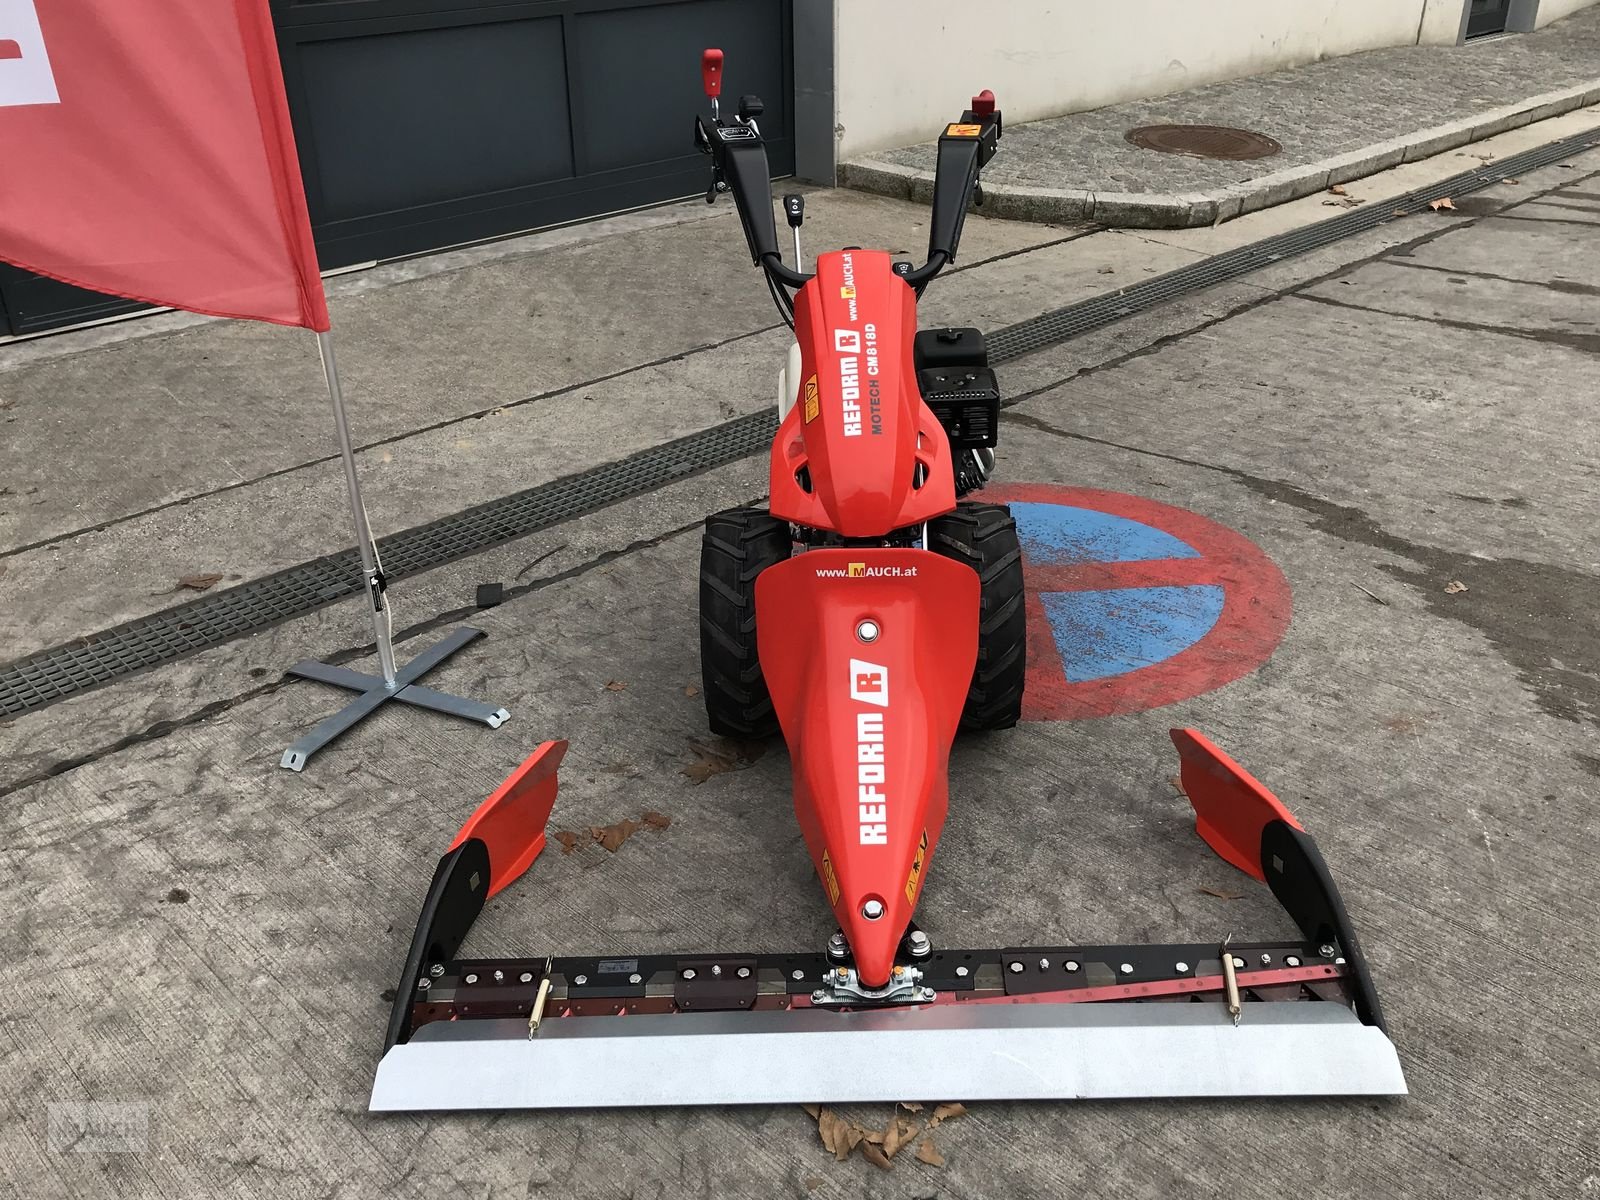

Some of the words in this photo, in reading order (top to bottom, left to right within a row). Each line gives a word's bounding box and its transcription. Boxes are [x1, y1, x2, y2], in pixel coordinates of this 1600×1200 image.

[842, 253, 857, 321] www.MAUCH.at
[865, 324, 879, 375] CM818D
[840, 357, 862, 436] REFORM
[869, 379, 882, 435] MOTECH
[816, 565, 917, 577] www.MAUCH.at
[857, 713, 887, 845] REFORM
